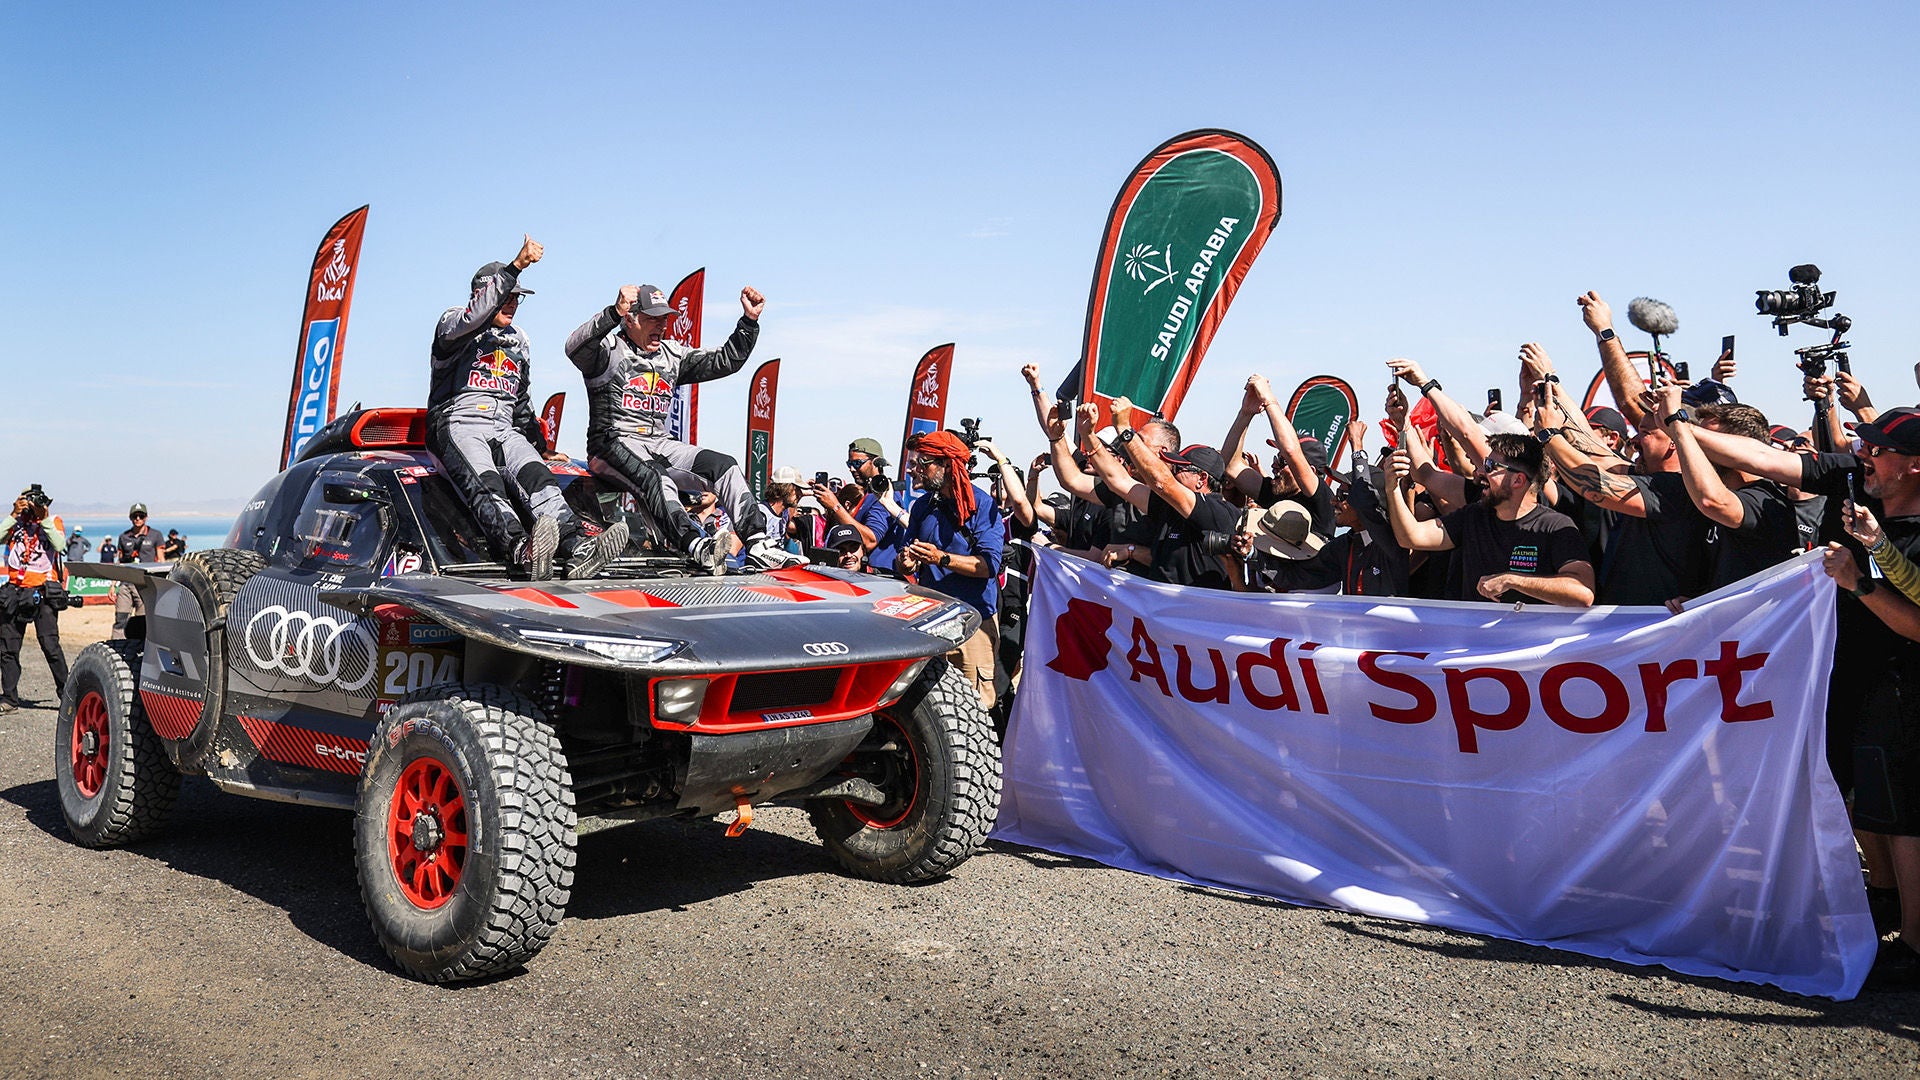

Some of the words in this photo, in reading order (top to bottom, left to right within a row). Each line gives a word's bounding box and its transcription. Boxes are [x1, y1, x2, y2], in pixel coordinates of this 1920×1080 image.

[1151, 295, 1193, 361] SAUDI
[1184, 215, 1240, 295] ARABIA
[467, 370, 500, 389] Red
[621, 393, 651, 411] Red
[90, 580, 112, 588] SAUD
[384, 651, 458, 694] 204
[1130, 617, 1330, 716] Audi
[1357, 640, 1776, 754] Sport
